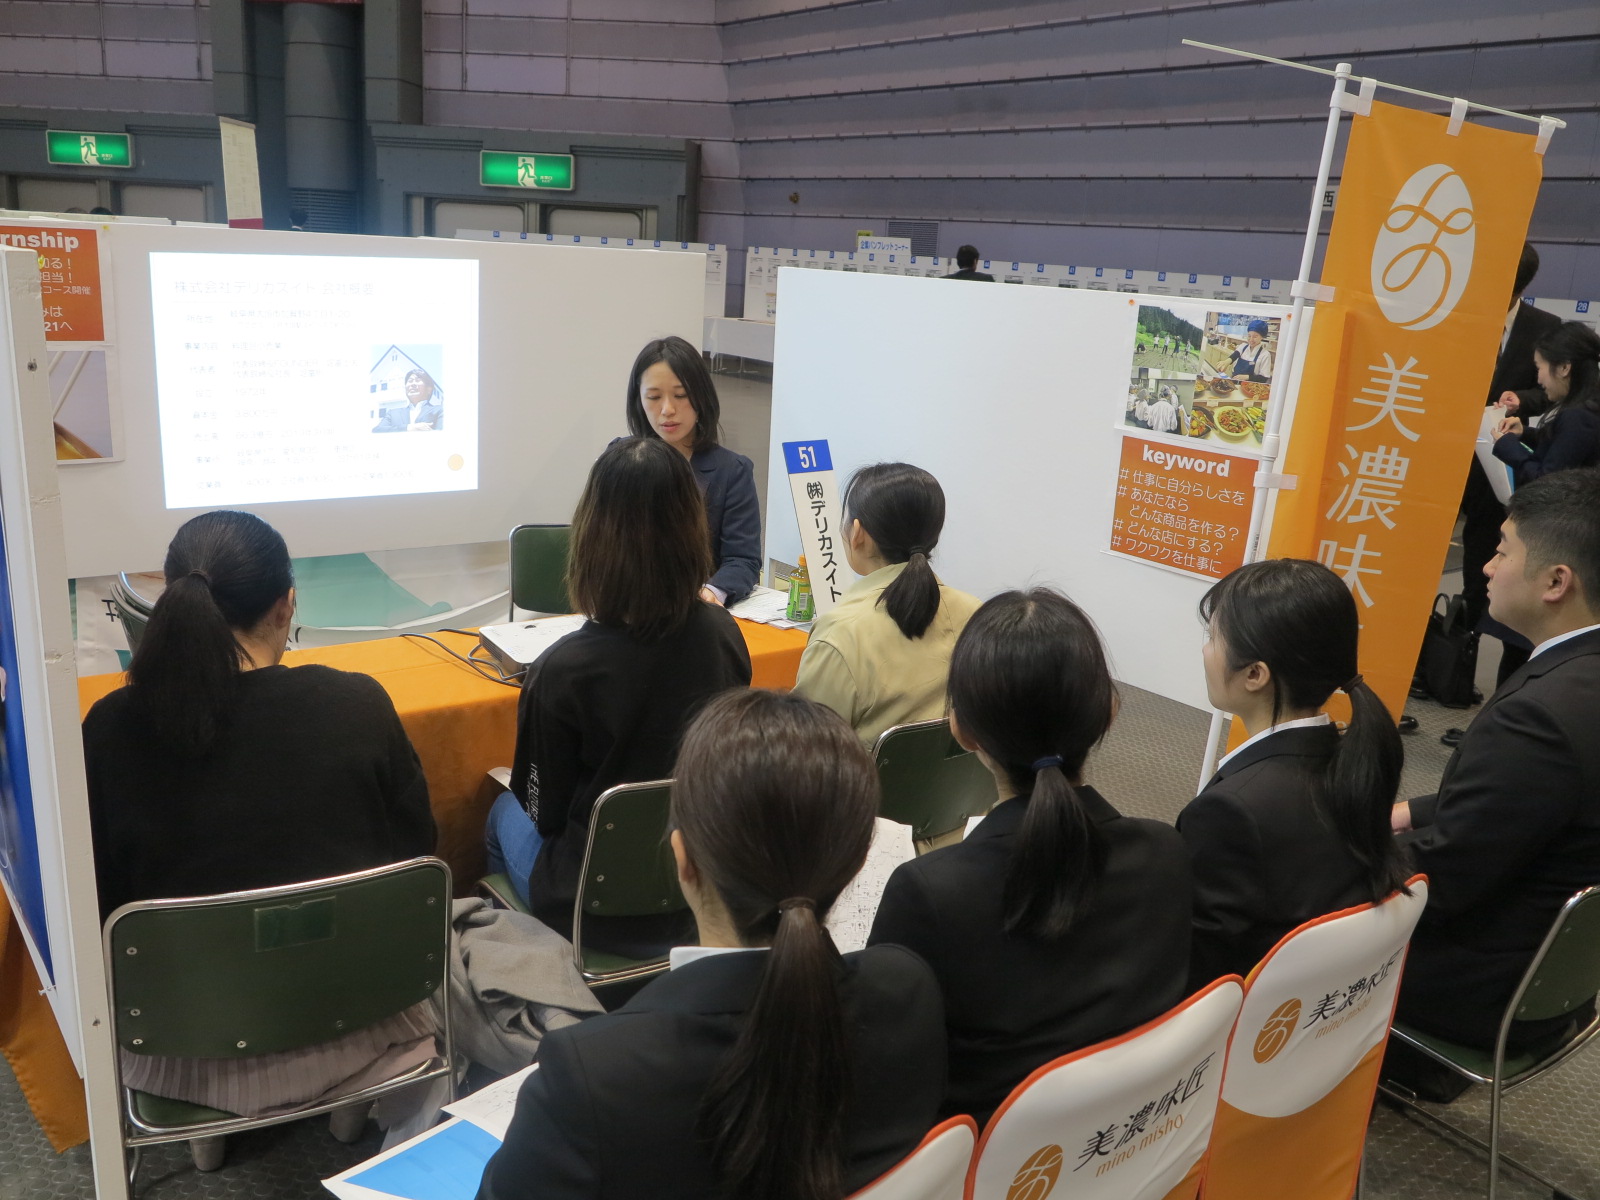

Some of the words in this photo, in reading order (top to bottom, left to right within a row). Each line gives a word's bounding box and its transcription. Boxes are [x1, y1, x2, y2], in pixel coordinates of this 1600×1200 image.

[41, 286, 91, 295] コース開催
[1261, 280, 1270, 289] 35
[1577, 301, 1588, 312] 28
[798, 445, 817, 470] 51
[1142, 444, 1231, 477] keyword
[1317, 352, 1429, 610] 美濃味
[1129, 504, 1240, 542] どんな商品を作る？
[1073, 1051, 1216, 1173] 美濃味匠
[1095, 1145, 1137, 1178] mino
